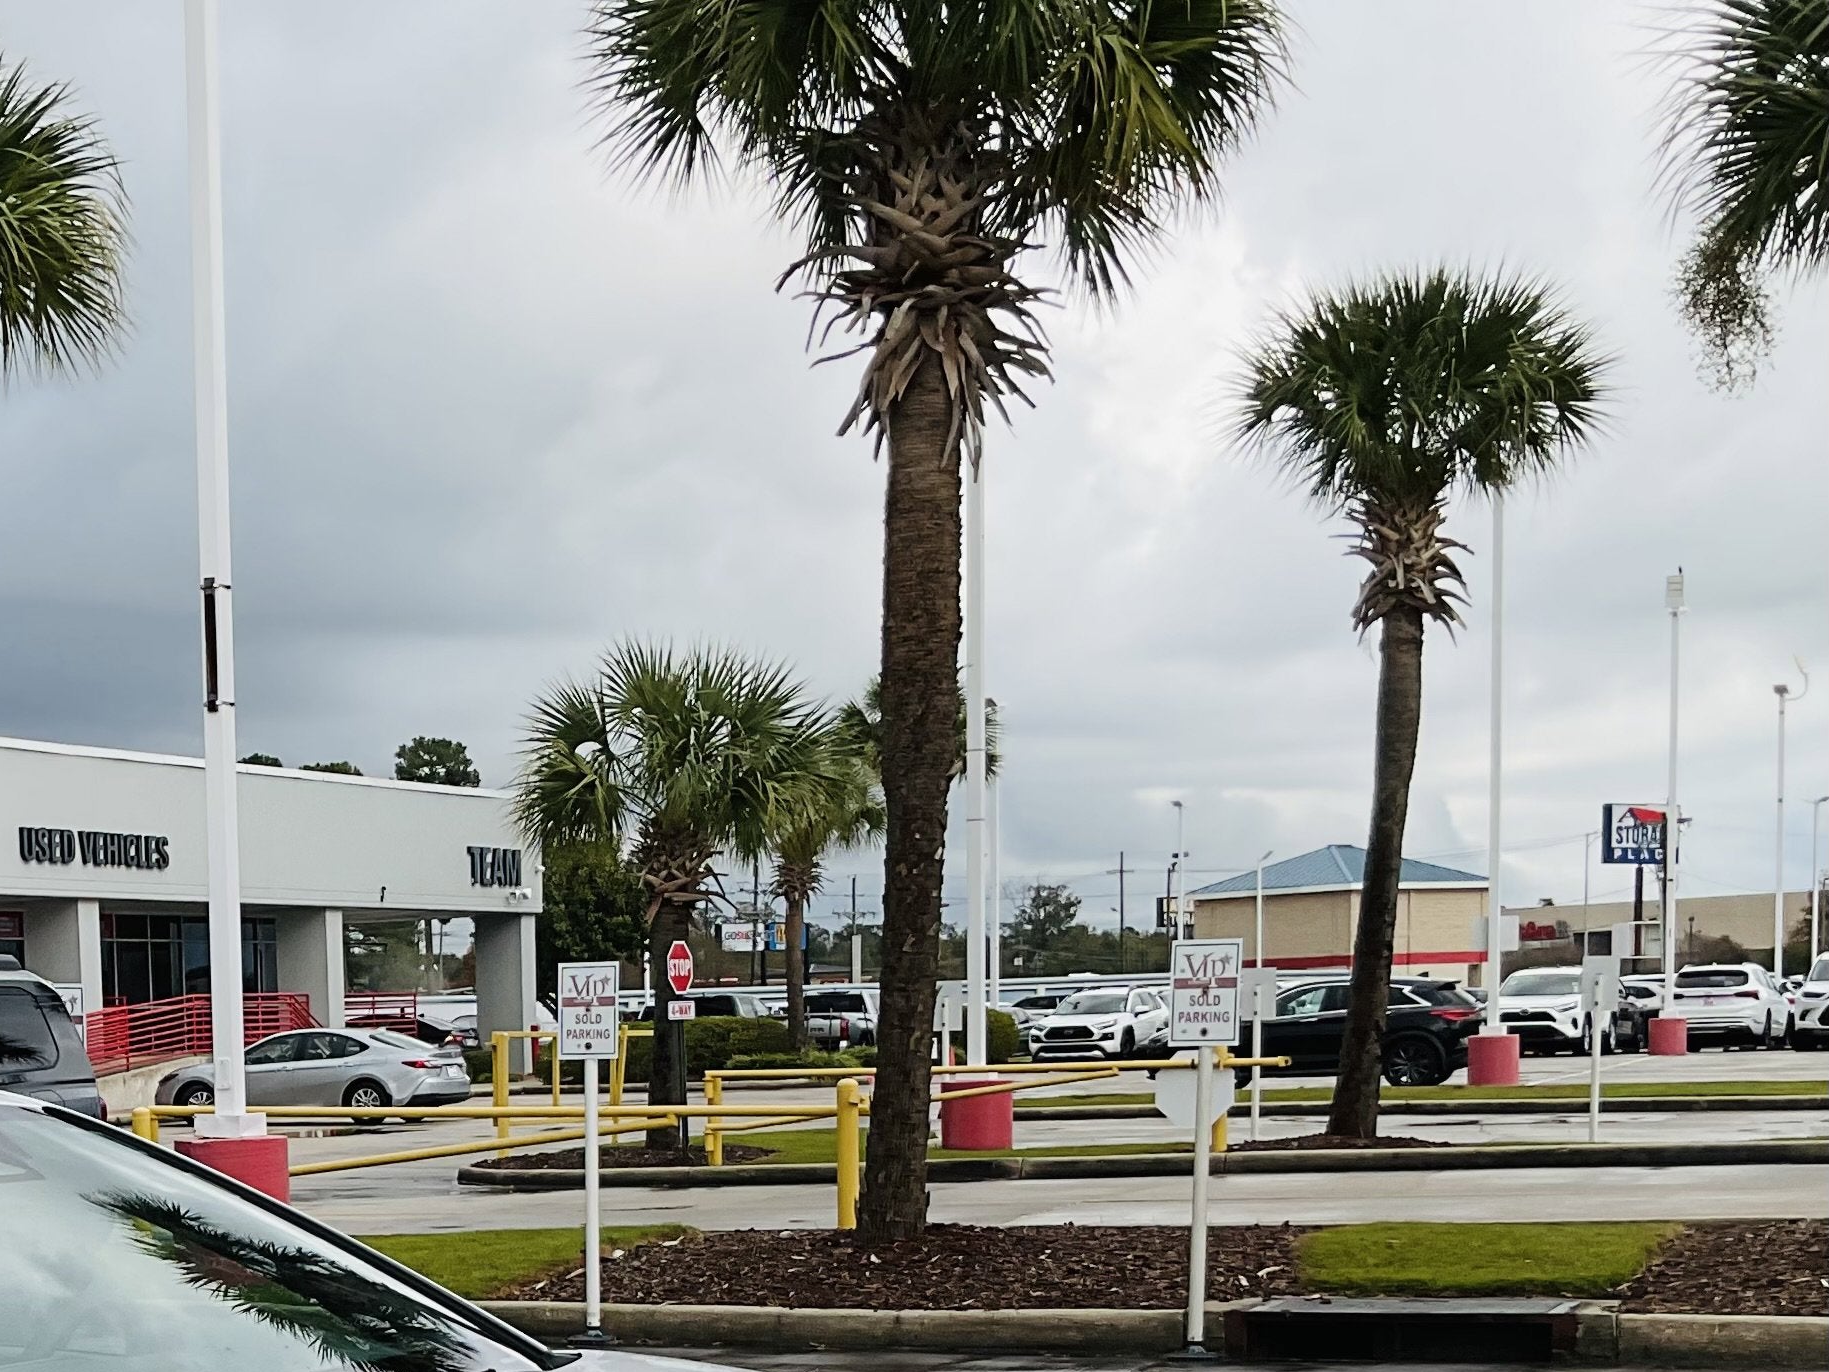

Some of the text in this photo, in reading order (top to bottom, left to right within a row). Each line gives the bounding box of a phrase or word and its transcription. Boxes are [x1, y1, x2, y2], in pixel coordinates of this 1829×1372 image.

[19, 827, 170, 870] USED VEHICLES
[1614, 848, 1663, 860] PLAC
[467, 846, 521, 887] TEAM
[669, 958, 691, 977] STOP
[1189, 994, 1221, 1007] SOLD
[671, 1005, 692, 1016] 4-WAY
[1178, 1011, 1230, 1023] PARKING
[575, 1013, 602, 1025] SOLD
[566, 1028, 611, 1041] PARKING
